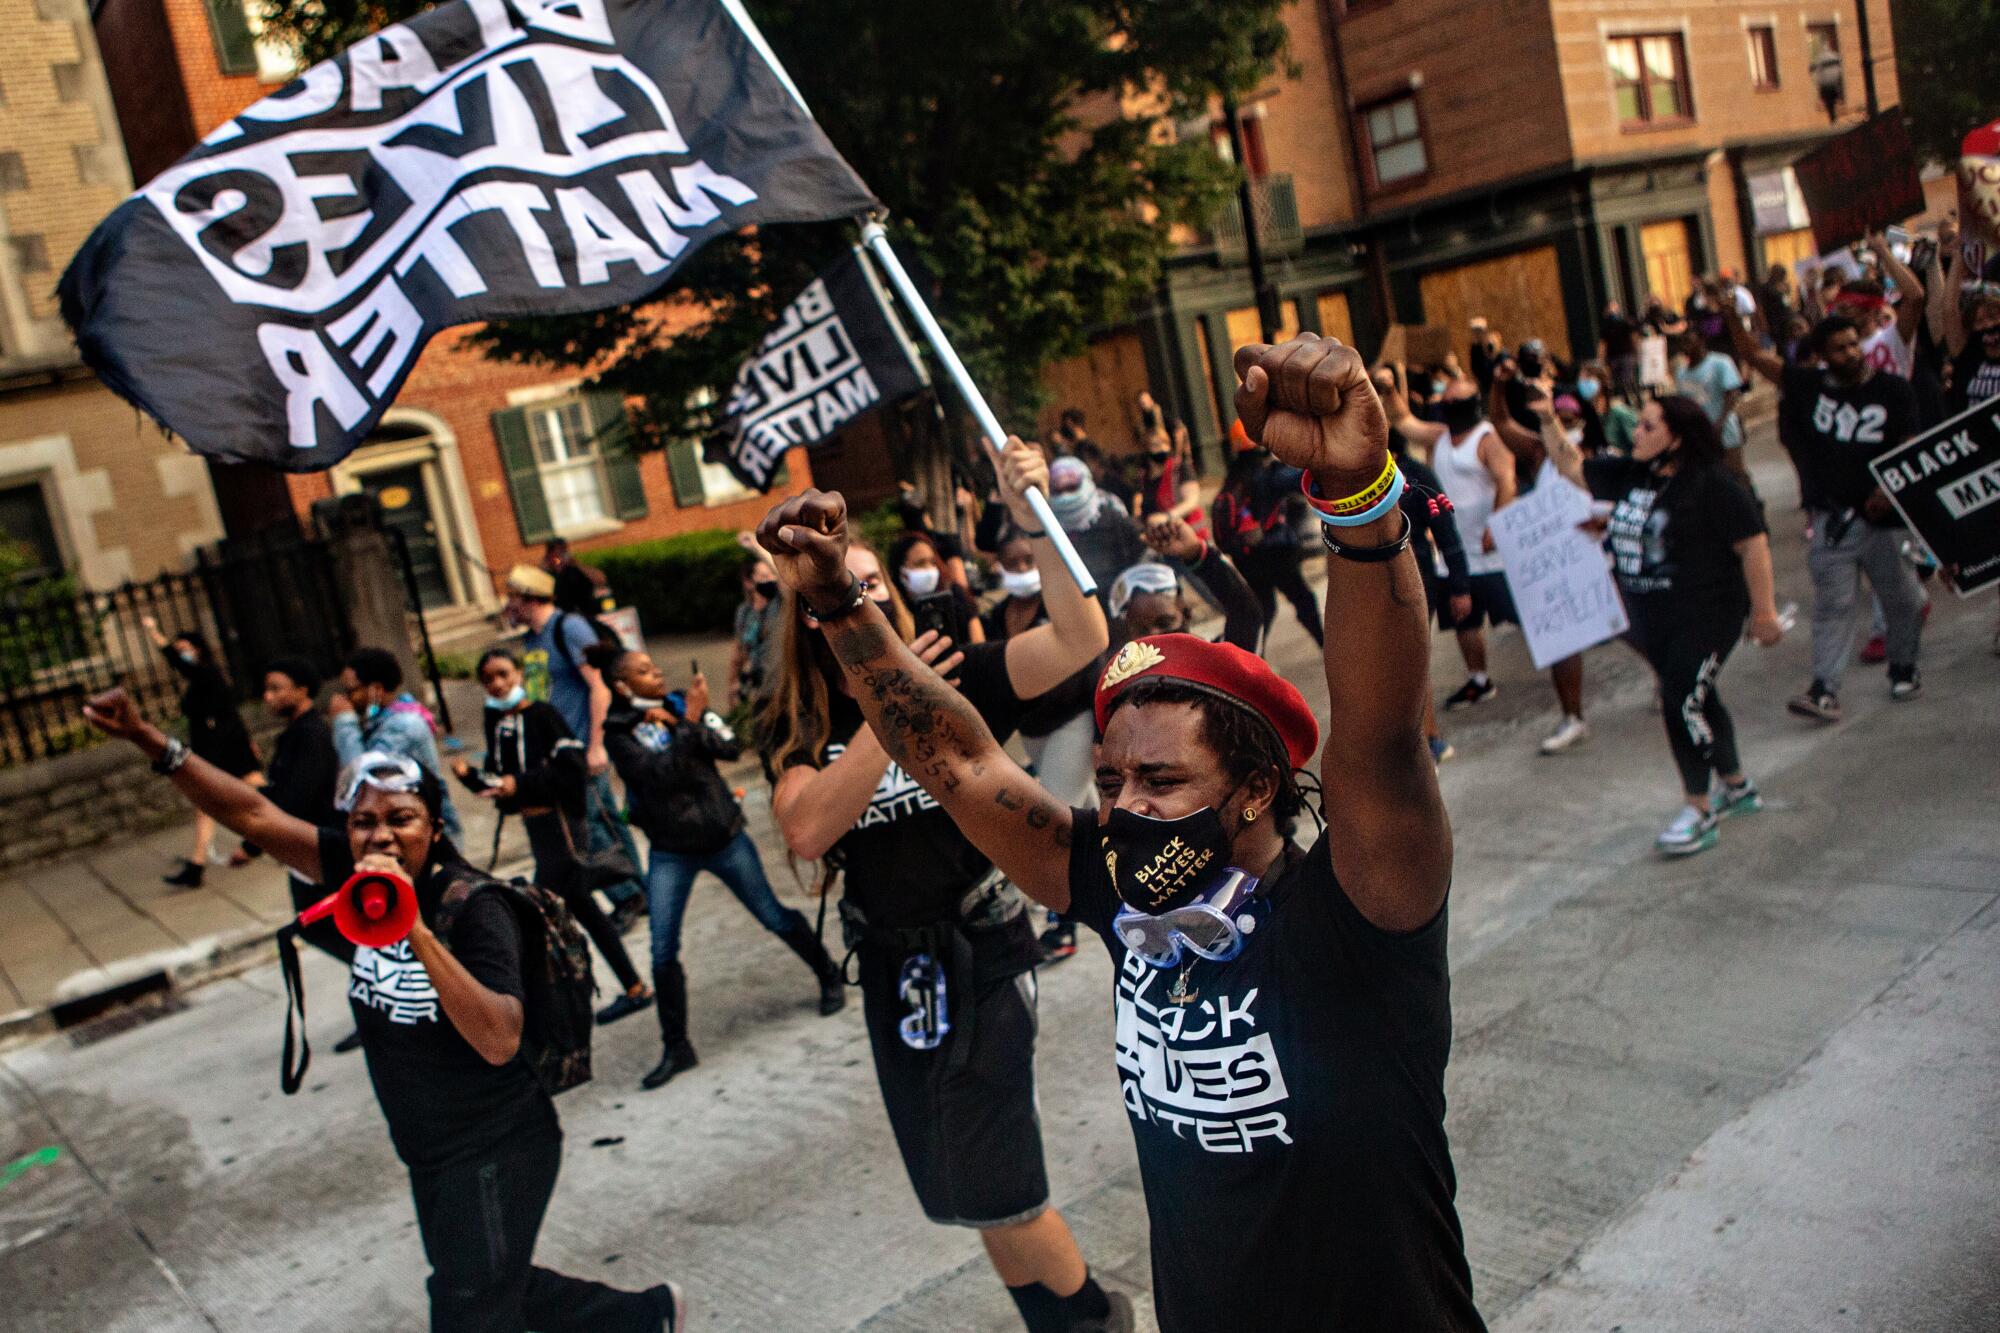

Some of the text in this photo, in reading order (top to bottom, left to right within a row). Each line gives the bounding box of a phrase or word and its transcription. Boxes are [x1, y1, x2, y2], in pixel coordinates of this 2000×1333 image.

[1882, 429, 1980, 493] BLACK
[1333, 463, 1394, 511] LIVES MATTER
[1953, 466, 2000, 509] MA
[851, 788, 941, 830] ATTE
[1135, 836, 1185, 884] BLACK
[1147, 847, 1196, 894] LIVES
[1149, 848, 1214, 907] MATTER
[350, 977, 439, 1025] ATTER
[1122, 1077, 1294, 1153] ATTER
